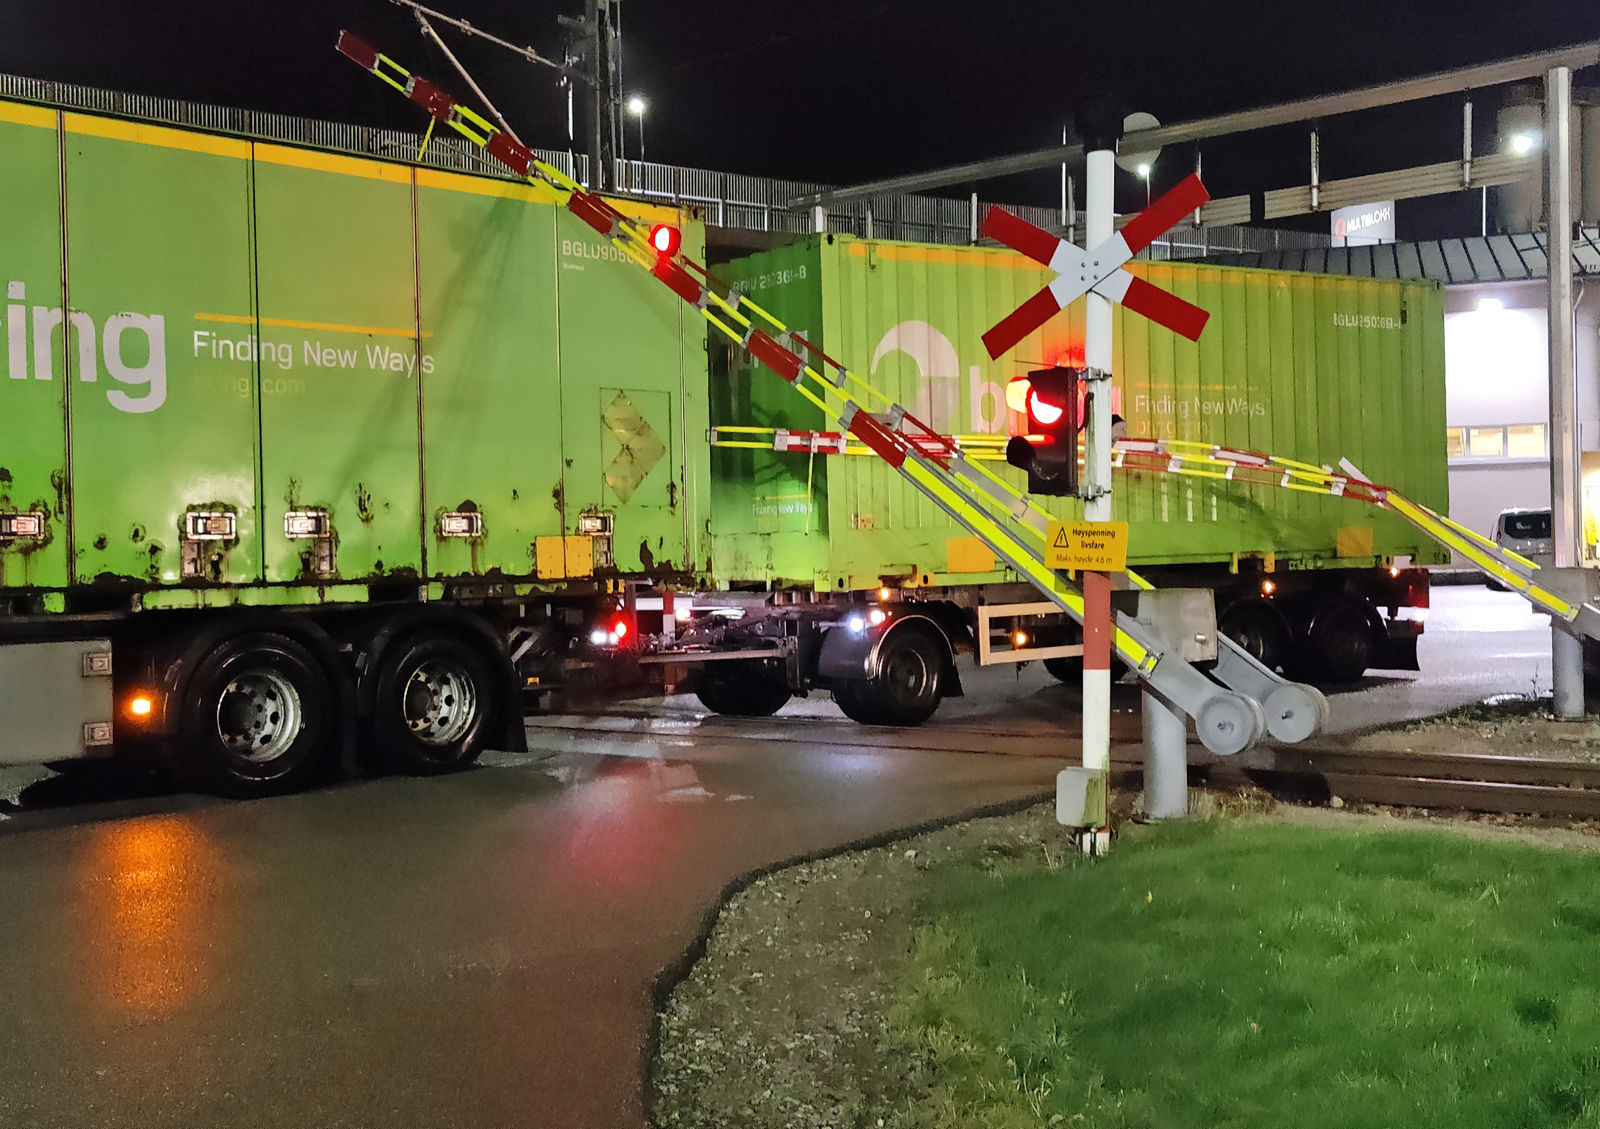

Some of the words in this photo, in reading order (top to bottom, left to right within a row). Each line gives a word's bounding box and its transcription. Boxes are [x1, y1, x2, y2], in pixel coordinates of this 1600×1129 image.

[0, 280, 167, 414] ing
[193, 330, 293, 370] Finding
[303, 340, 357, 369] New
[365, 344, 435, 378] Ways
[1135, 395, 1189, 418] Finding
[1072, 528, 1116, 539] Høyspenning
[1081, 540, 1105, 549] livsfare
